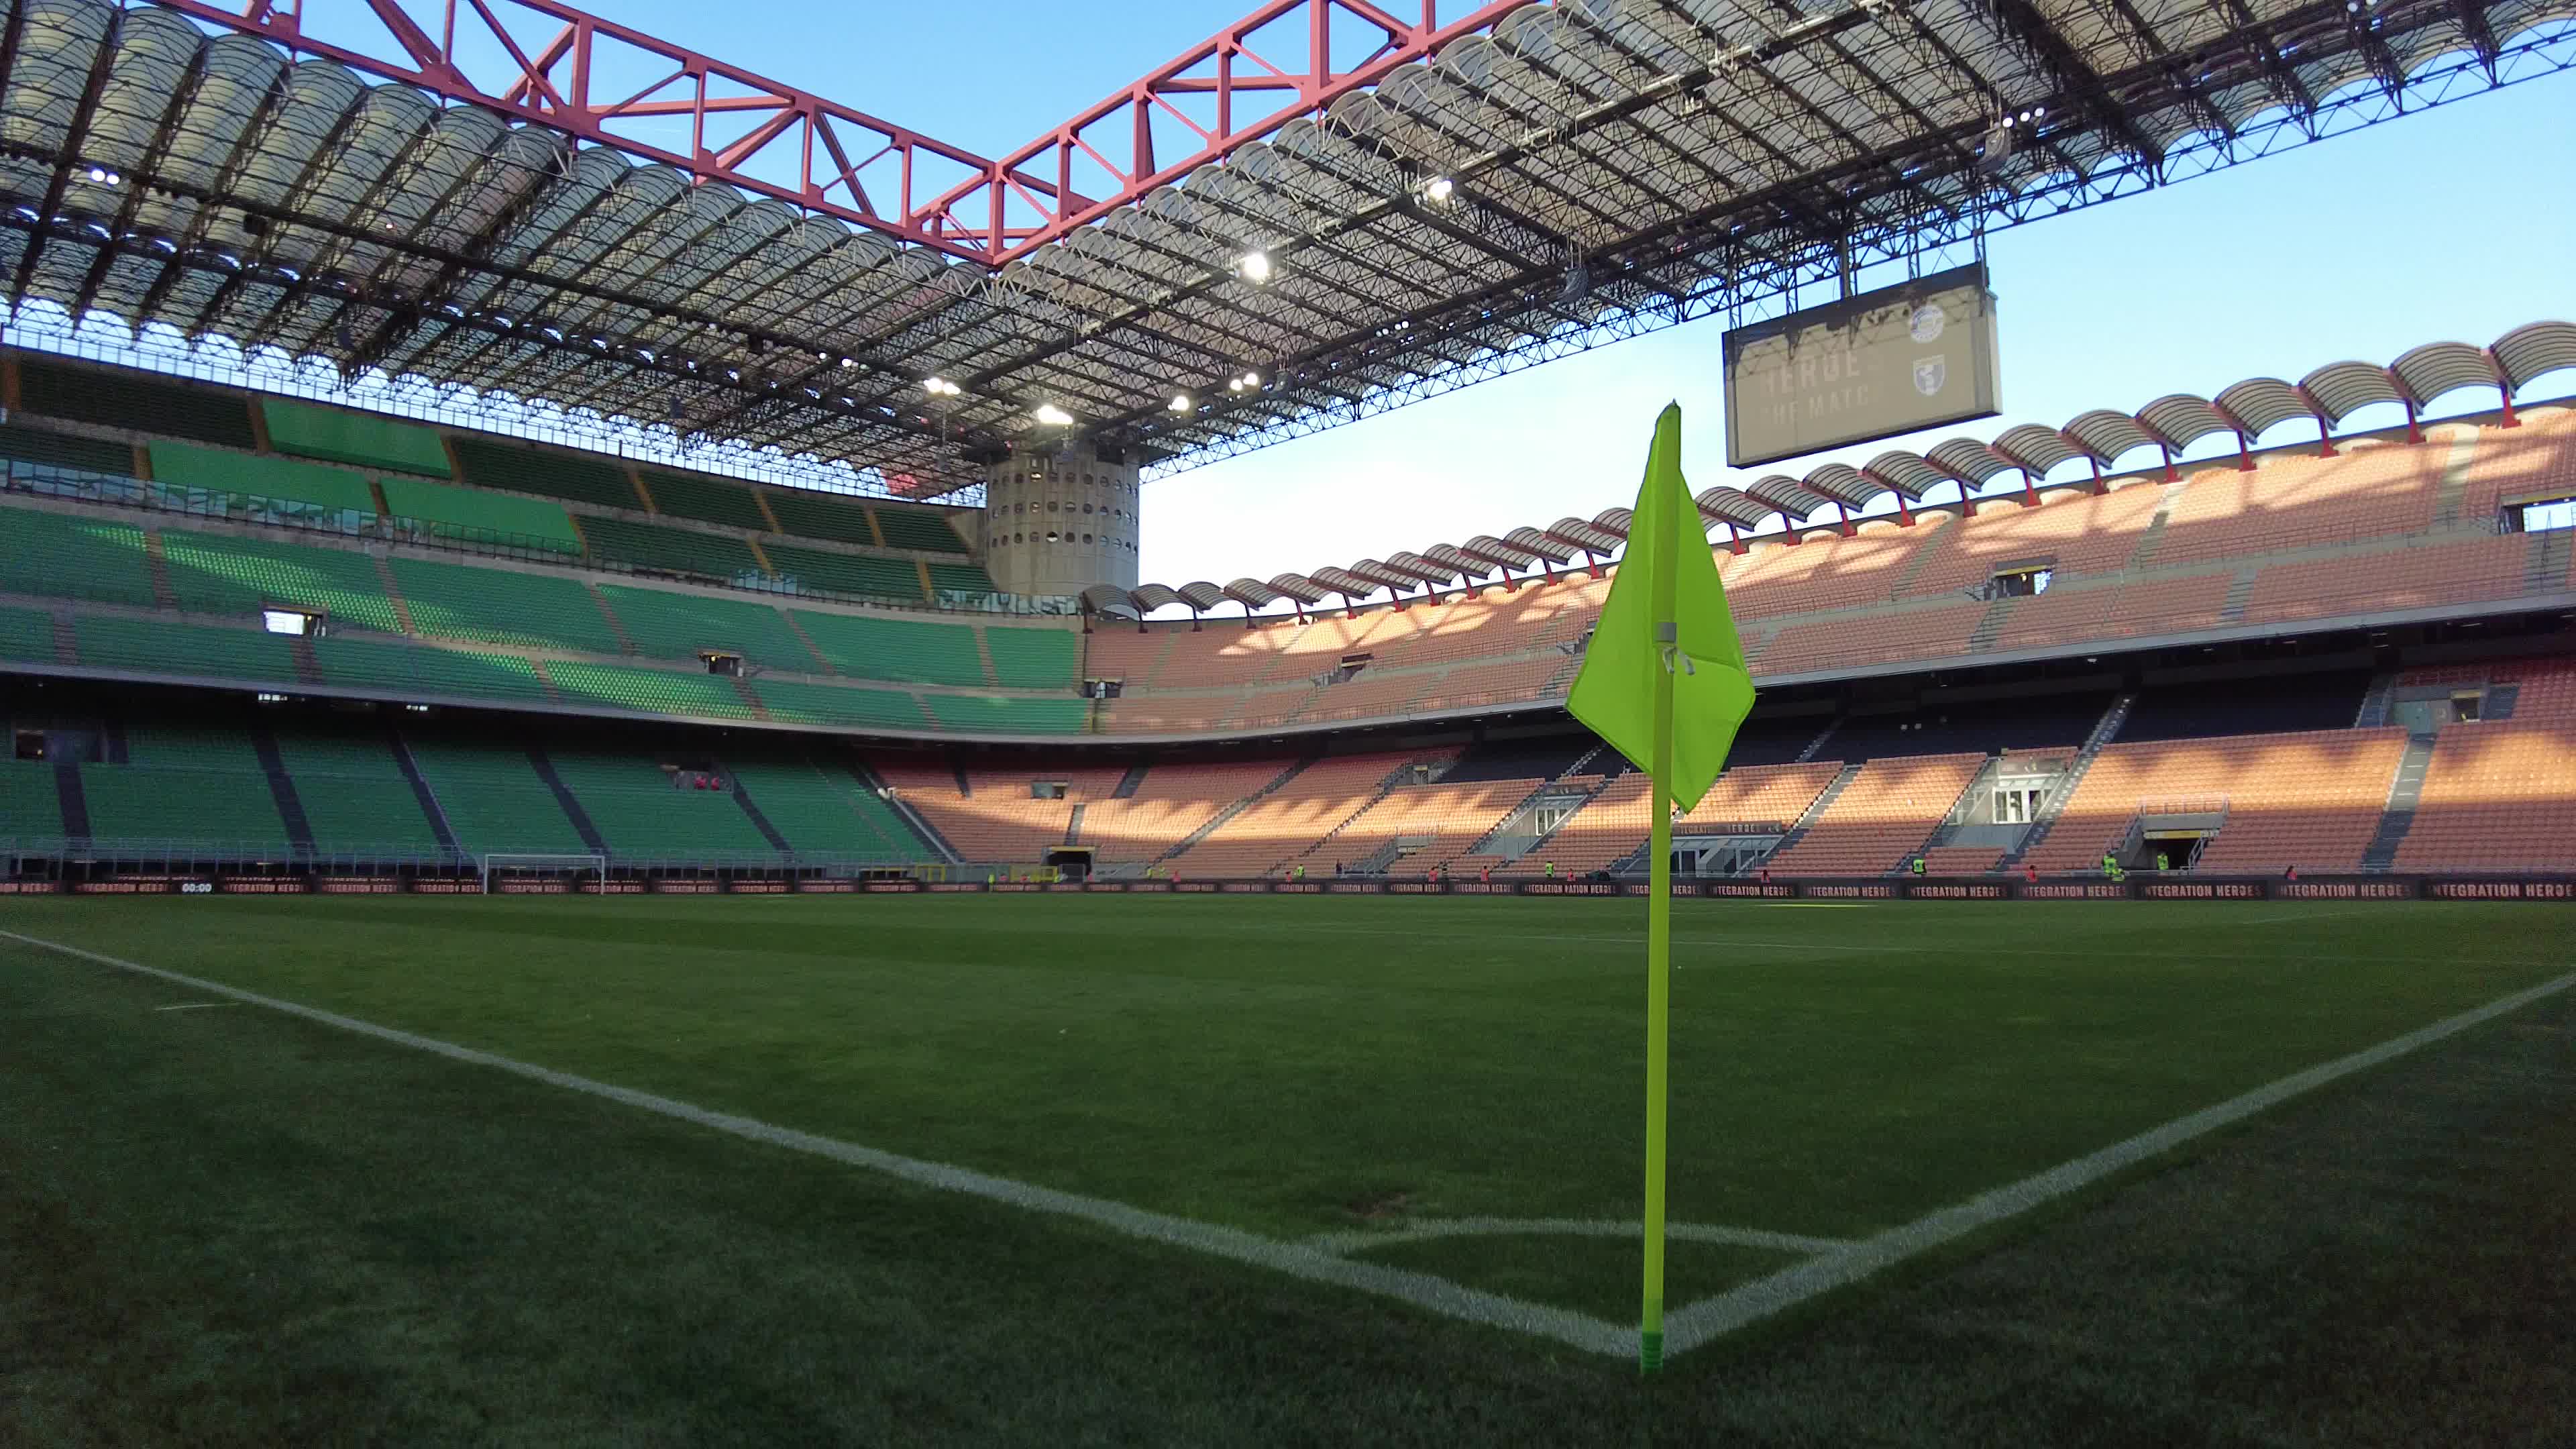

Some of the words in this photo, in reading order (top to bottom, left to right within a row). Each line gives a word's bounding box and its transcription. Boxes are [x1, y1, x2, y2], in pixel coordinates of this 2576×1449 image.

[182, 883, 212, 893] 00:00
[1672, 885, 1700, 896] HEROE
[1712, 885, 1760, 897] NTEGRATION
[1806, 886, 1859, 897] NTEGRATION
[1909, 886, 1966, 898] NTEGRATION
[2279, 885, 2356, 898] NTEGRATION
[2361, 885, 2408, 898] HEROE
